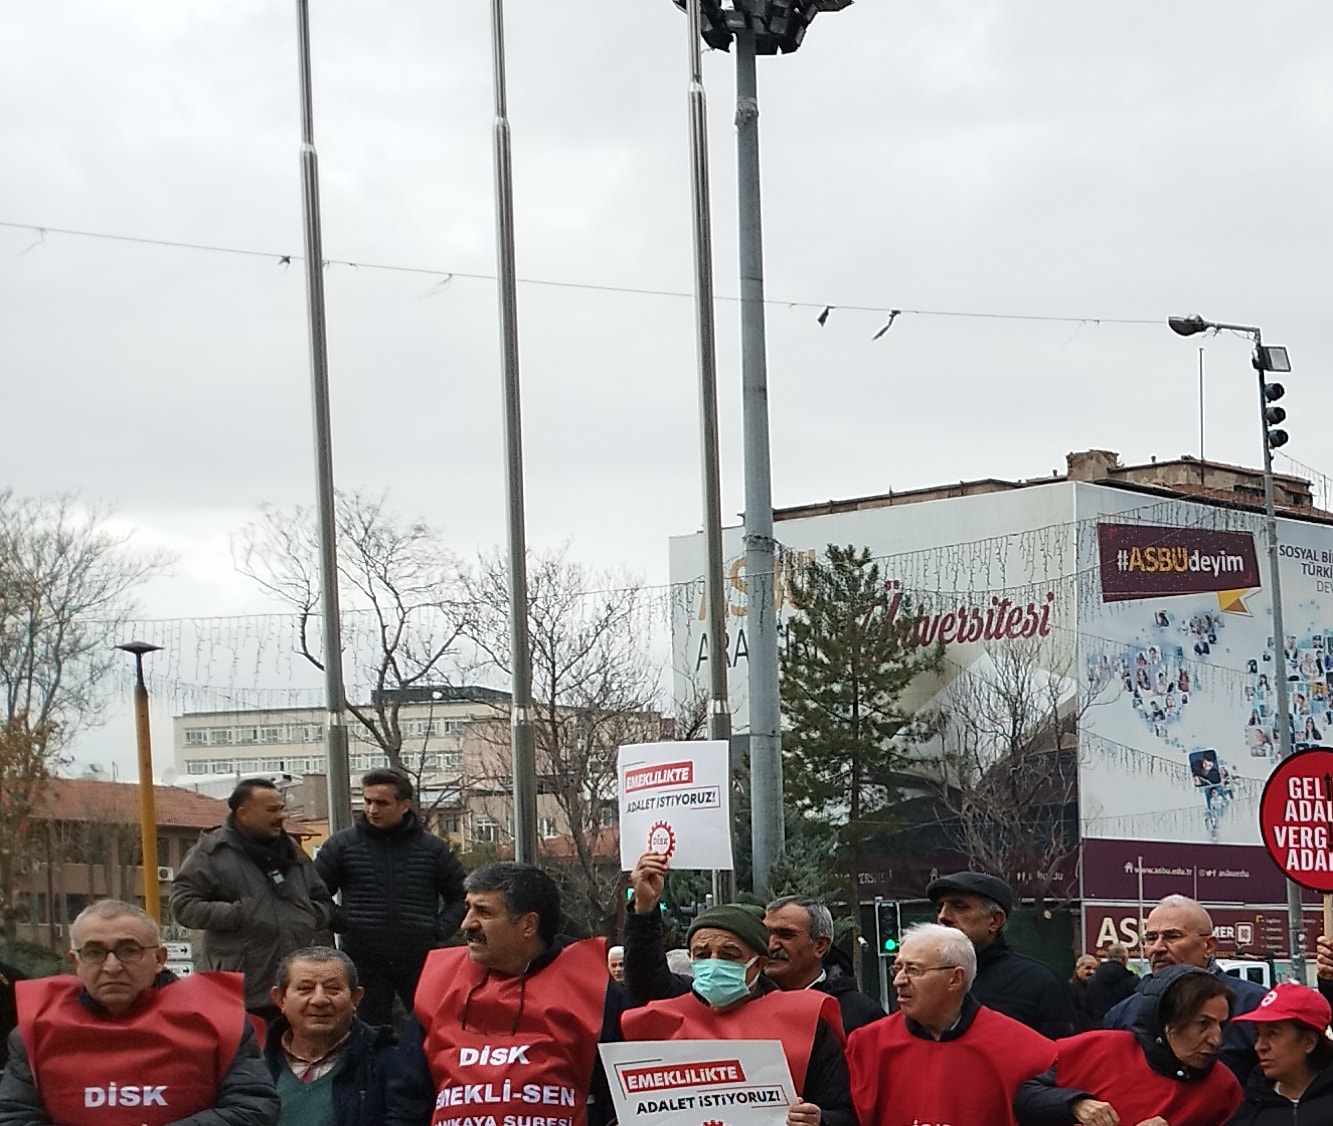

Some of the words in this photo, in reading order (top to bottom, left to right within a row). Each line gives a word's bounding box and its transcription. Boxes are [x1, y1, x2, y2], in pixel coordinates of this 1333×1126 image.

[1279, 544, 1318, 562] SOSYAL
[626, 798, 655, 814] ADALET
[459, 1044, 531, 1066] DİSK
[627, 1066, 738, 1090] EMEKLİLİKTE
[84, 1081, 169, 1108] DİSK
[636, 1096, 696, 1115] ADALET
[698, 1089, 781, 1108] İSTİYORUZ!
